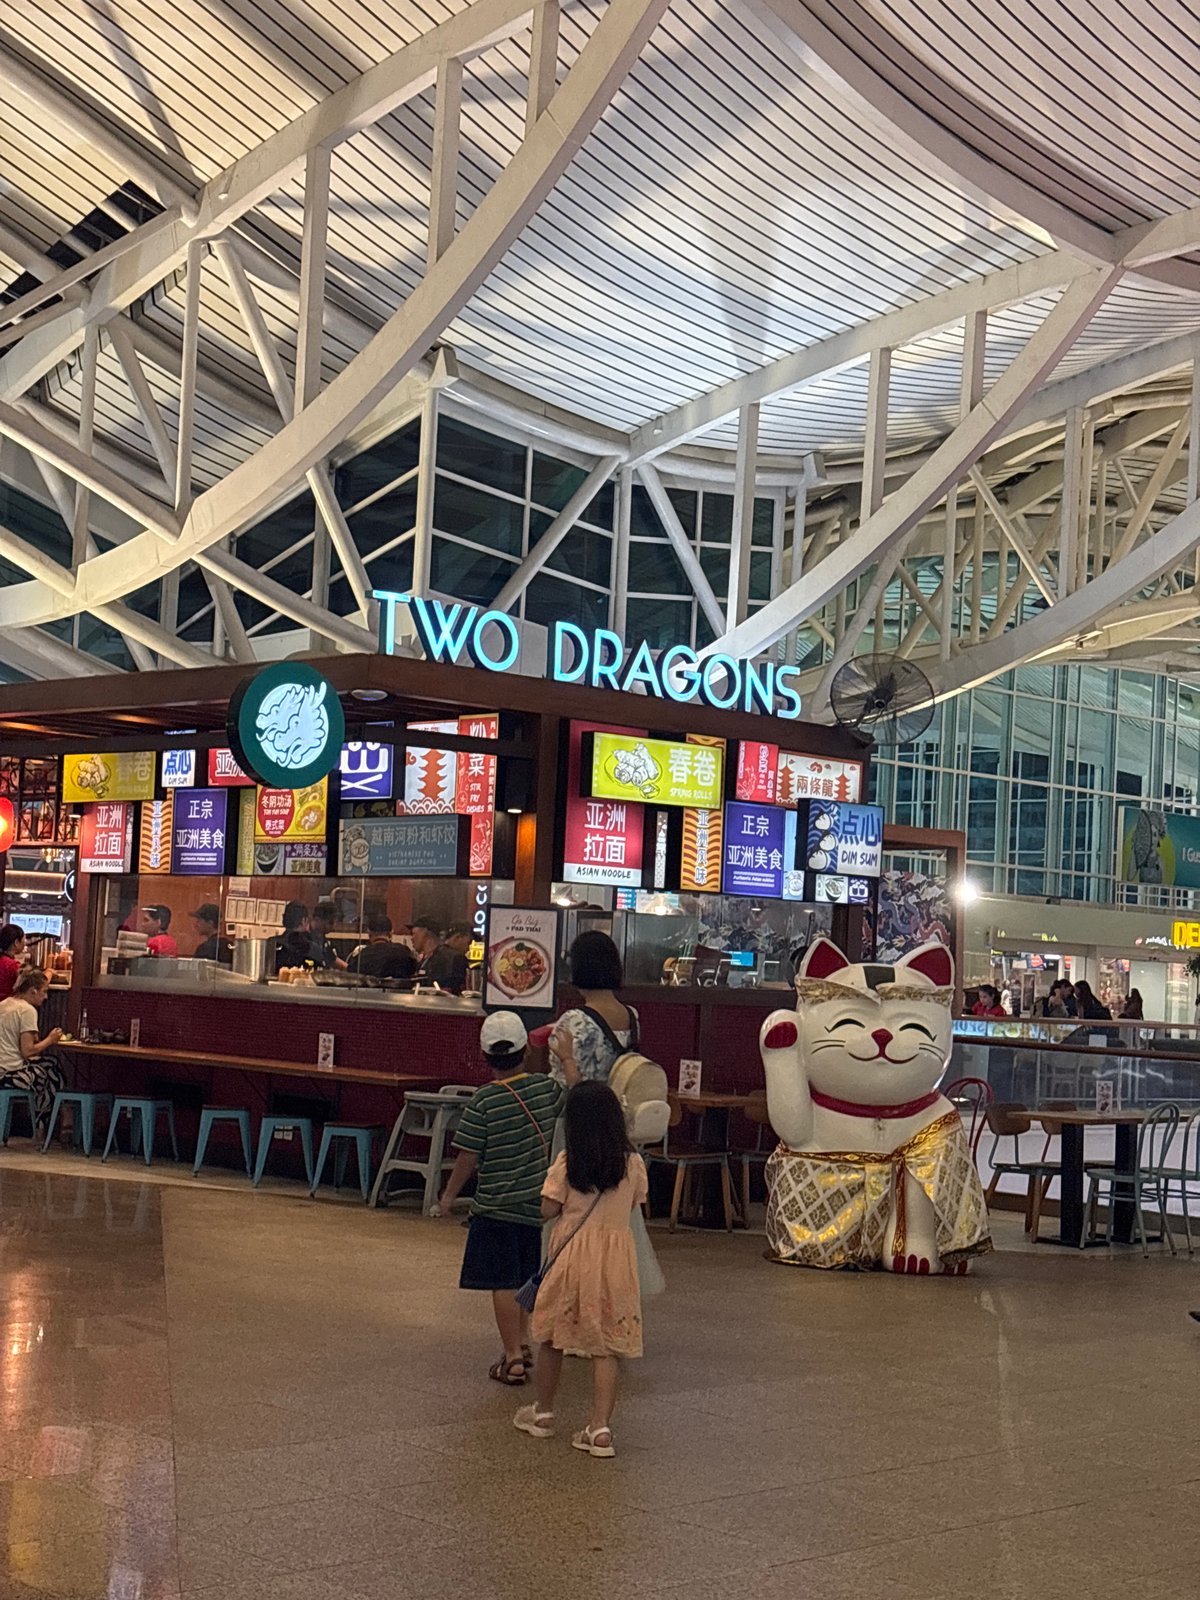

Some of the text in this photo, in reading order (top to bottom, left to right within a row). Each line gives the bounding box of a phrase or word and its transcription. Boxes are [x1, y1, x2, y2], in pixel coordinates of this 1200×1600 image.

[370, 590, 801, 719] TWO DRAGONS
[164, 750, 192, 775] 点心
[668, 748, 716, 787] 春卷
[796, 774, 834, 797] 兩條龍
[187, 798, 213, 819] 正宗
[470, 794, 481, 802] FRY
[95, 804, 122, 829] 亚洲
[584, 802, 626, 833] 亚洲
[740, 814, 770, 837] 正宗
[175, 828, 224, 849] 亚洲美食
[370, 824, 456, 847] 越南河粉和虾饺
[839, 811, 881, 847] 点心
[94, 832, 122, 856] 拉面
[583, 832, 626, 864] 拉面
[88, 860, 104, 868] ASIAN
[726, 845, 783, 871] 亚洲美食
[841, 850, 878, 866] DIM SUM
[576, 866, 632, 879] ASIAN NOODLE
